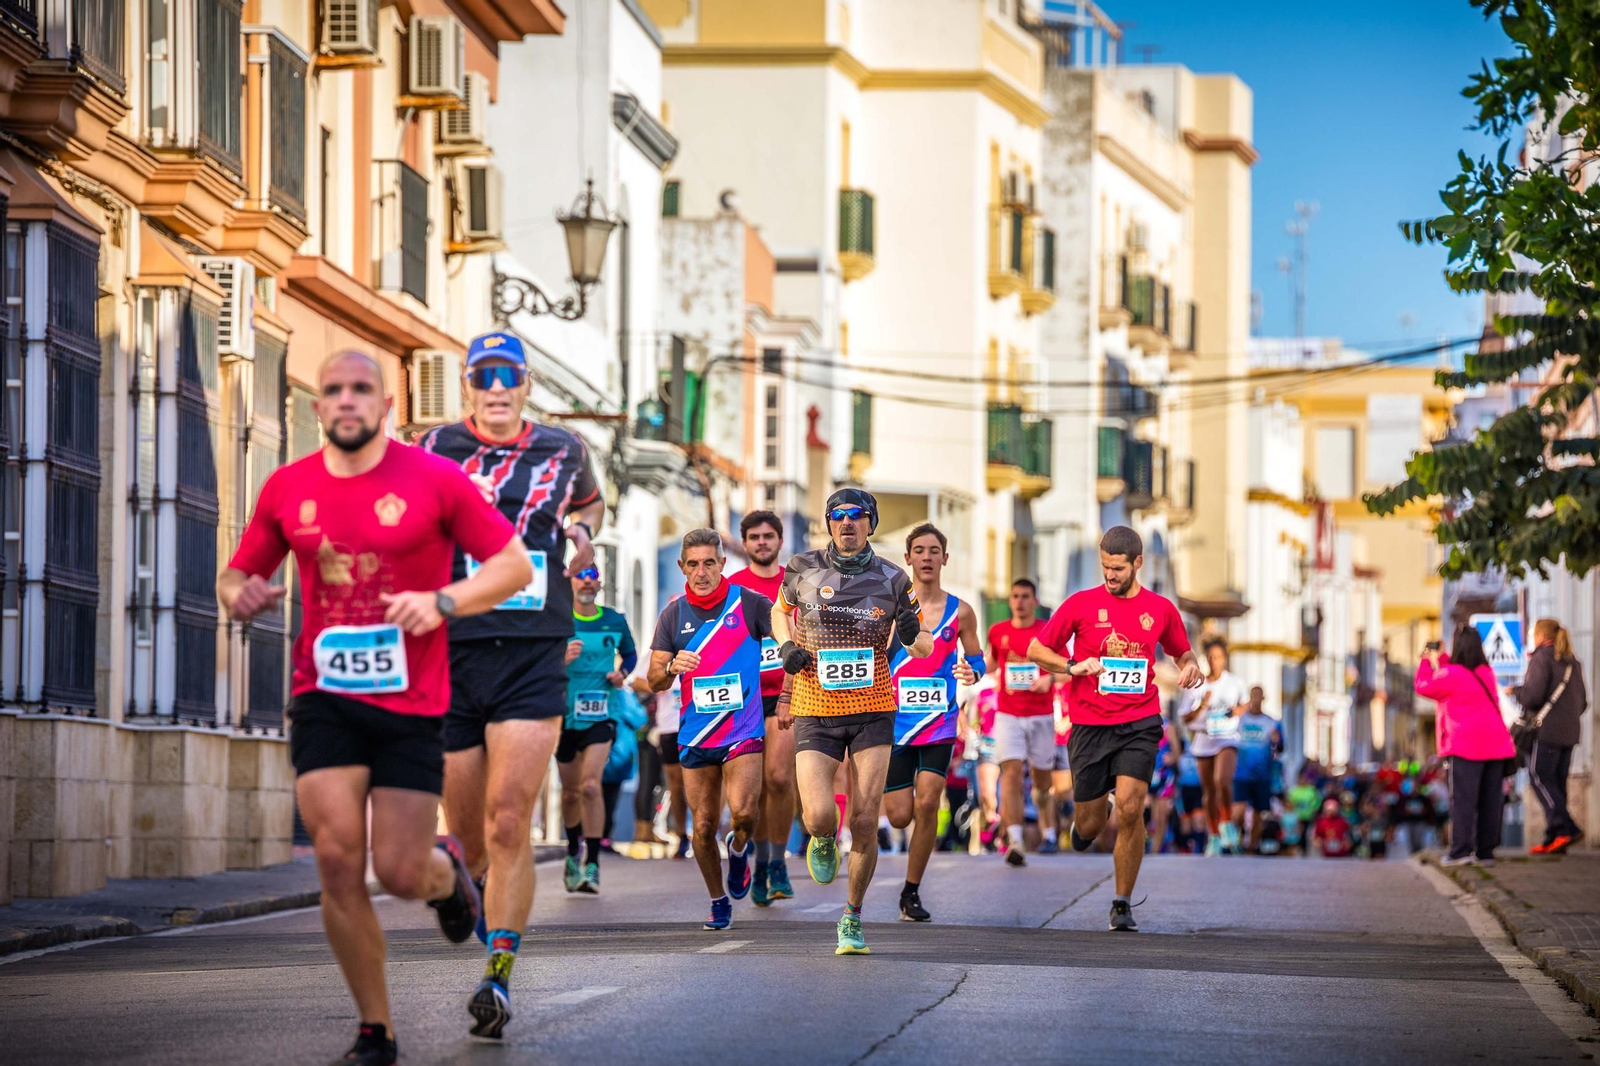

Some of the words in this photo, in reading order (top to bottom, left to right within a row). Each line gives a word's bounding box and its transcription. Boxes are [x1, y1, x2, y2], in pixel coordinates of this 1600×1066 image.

[805, 602, 822, 611] Club
[823, 603, 874, 615] Deporteando
[329, 650, 394, 673] 455
[826, 662, 868, 679] 285
[1107, 670, 1142, 684] 173
[705, 687, 730, 703] 12
[906, 690, 942, 703] 294
